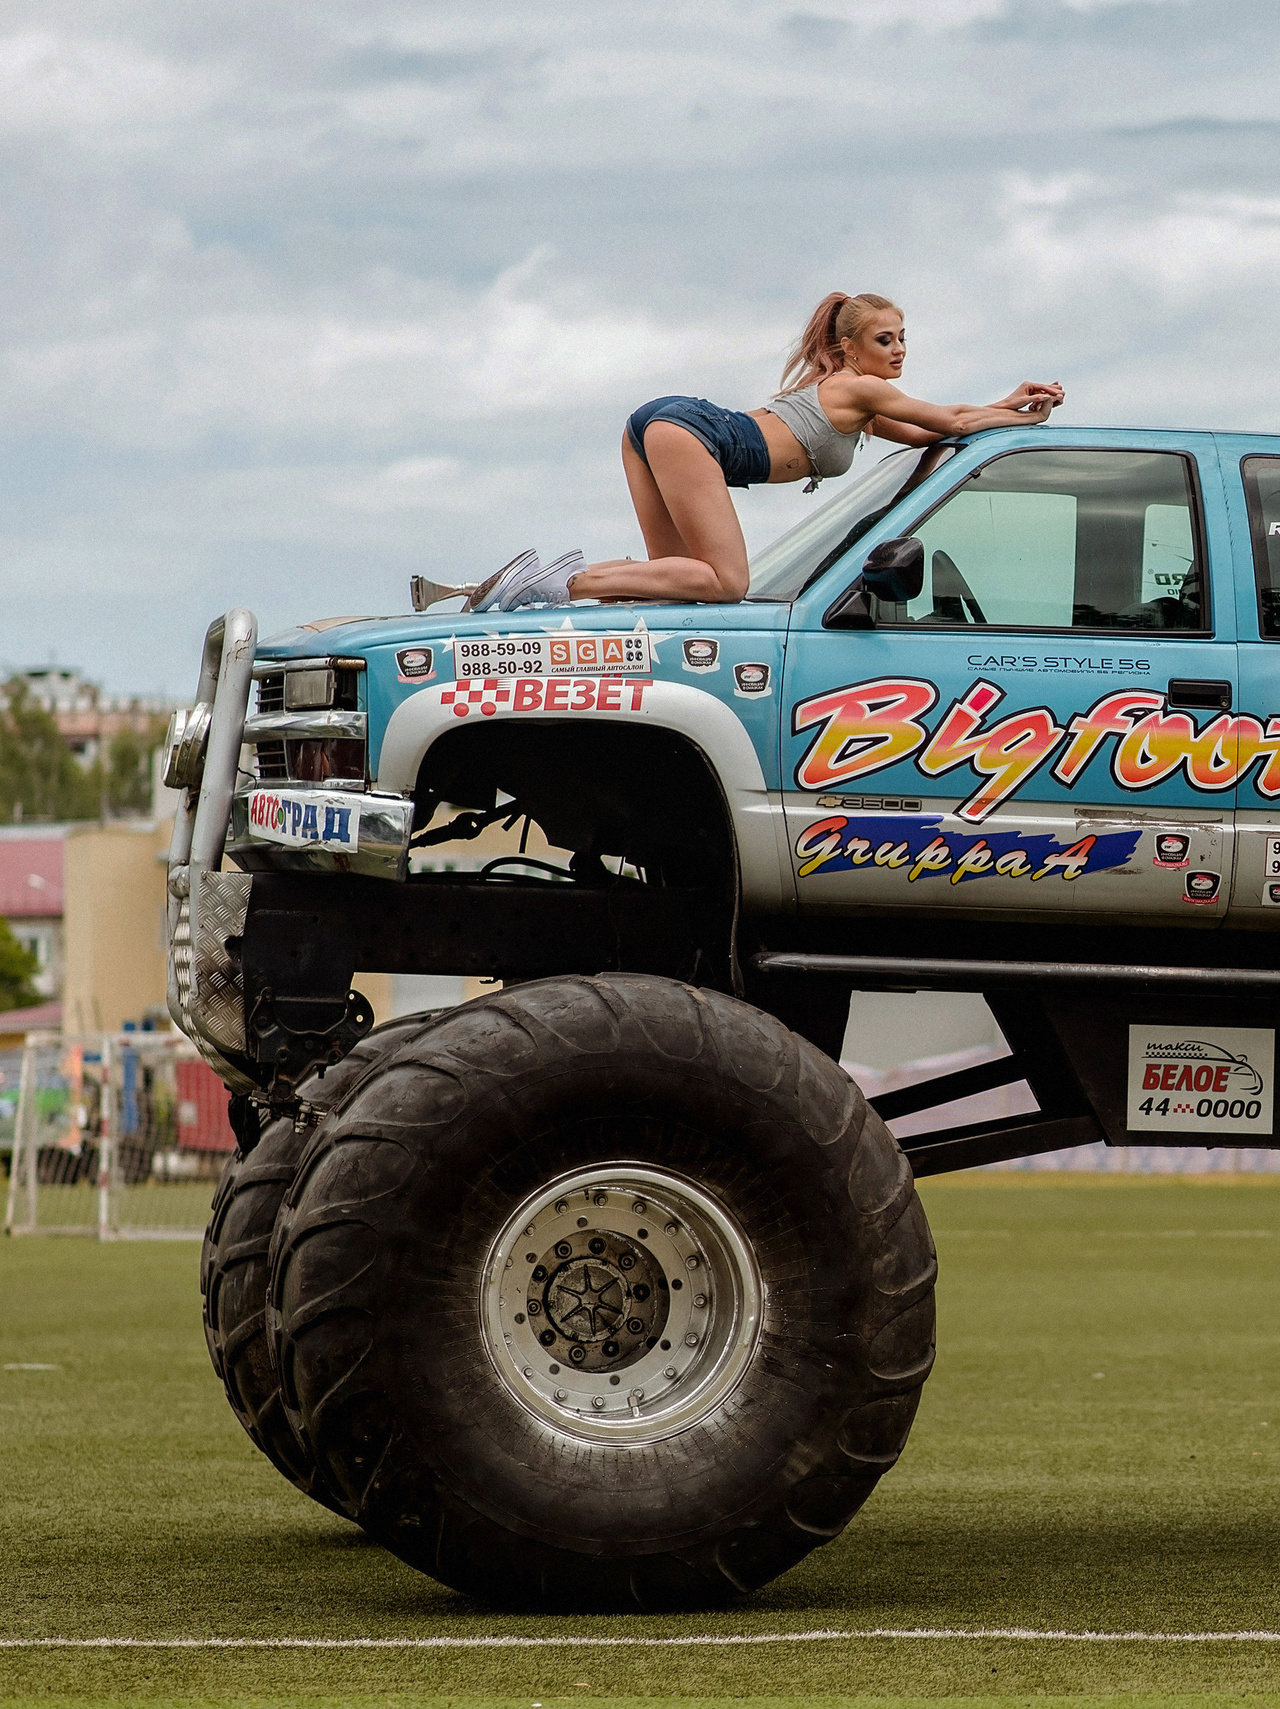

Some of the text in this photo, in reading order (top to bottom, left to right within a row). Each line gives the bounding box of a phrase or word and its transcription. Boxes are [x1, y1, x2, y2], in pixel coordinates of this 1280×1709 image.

[461, 642, 541, 657] 988-59-09
[553, 642, 622, 661] SGA
[462, 660, 543, 676] 988-50-92
[551, 664, 644, 673] САМЫЙ ГЛАВНЫЙ АВТОСАЛОН
[967, 655, 1150, 670] CAR'S STYLE 56
[842, 796, 922, 812] 3500
[1147, 1042, 1204, 1052] такси
[1142, 1063, 1231, 1092] БЕЛОЕ
[1138, 1097, 1262, 1119] 44 0000
